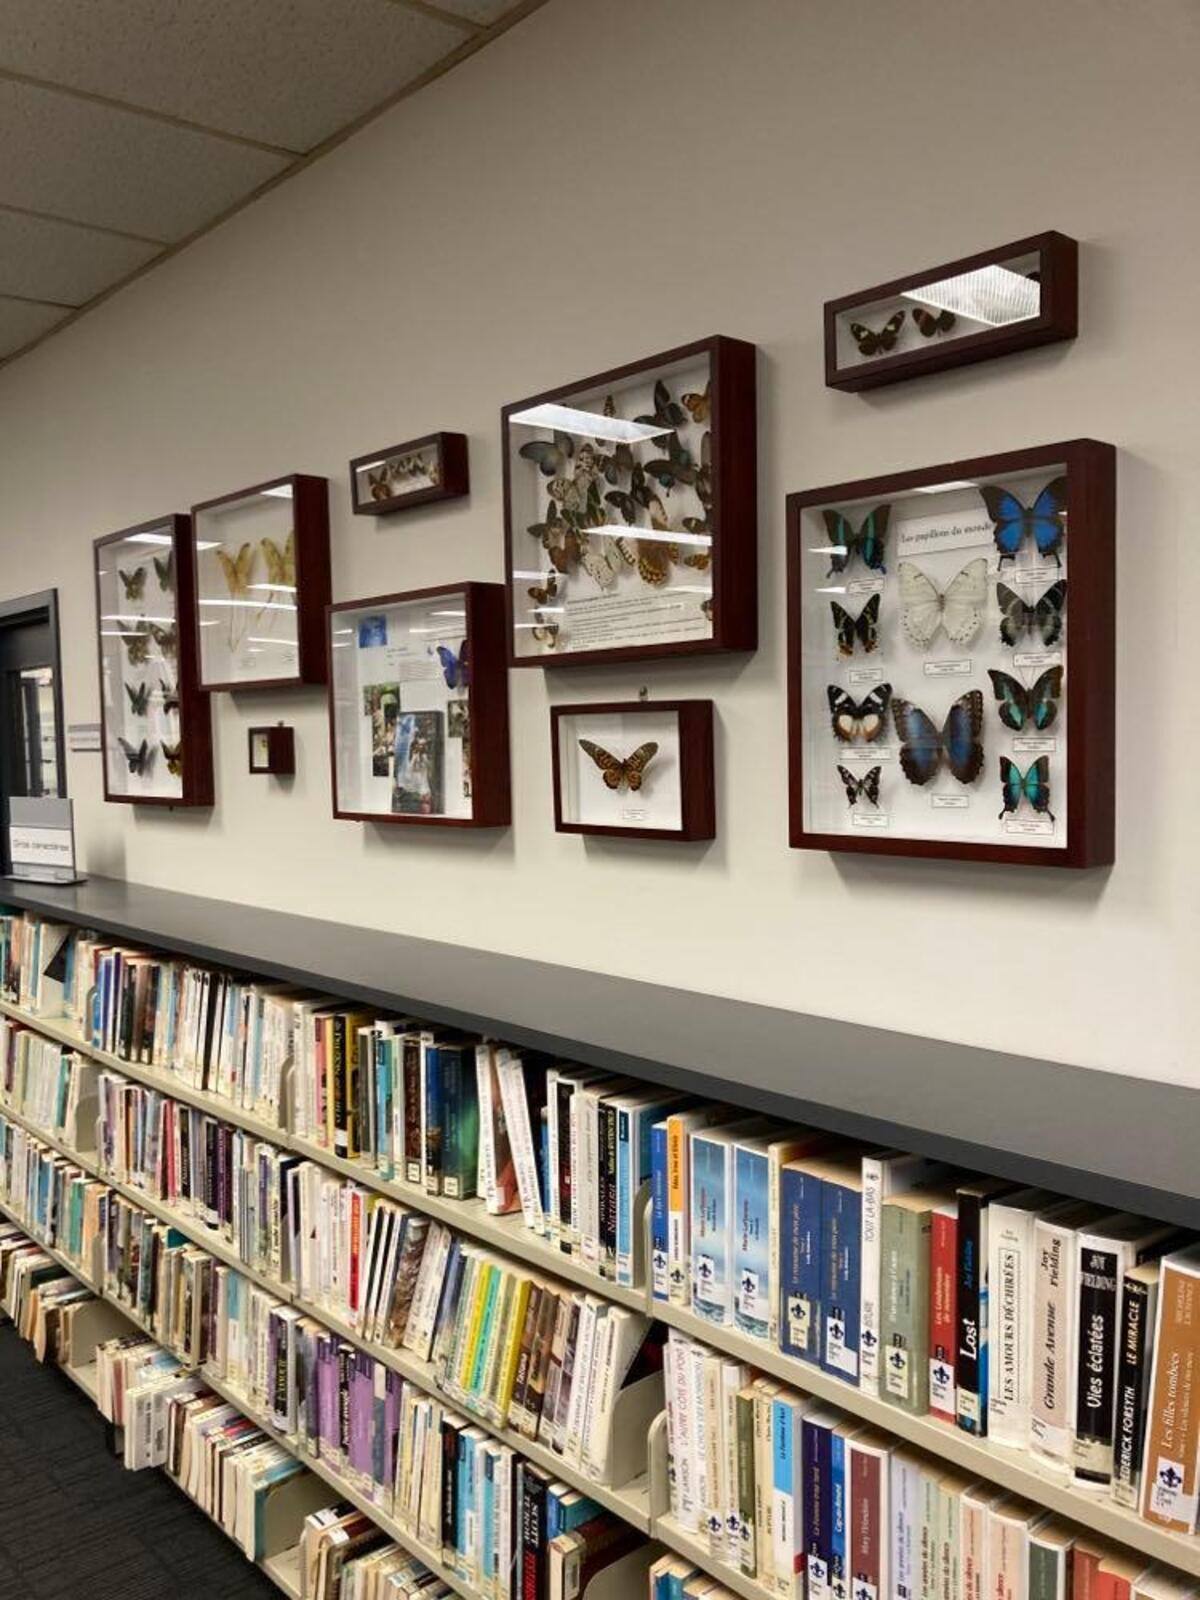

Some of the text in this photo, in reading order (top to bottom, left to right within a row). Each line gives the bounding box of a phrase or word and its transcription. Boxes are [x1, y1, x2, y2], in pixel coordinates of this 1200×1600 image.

[1041, 1249, 1049, 1270] Joy
[1048, 1238, 1061, 1287] Fielding
[960, 1317, 977, 1360] Lost
[1002, 1254, 1014, 1401] LES AMOURS DÉCHIRÉES
[1043, 1301, 1056, 1410] Grande Avenue
[1086, 1314, 1104, 1409] Vies éclatées
[1126, 1299, 1140, 1365] LE MIRACLE
[1119, 1385, 1136, 1479] EDERICK FORSYTH
[1161, 1352, 1180, 1448] Les filles tombées
